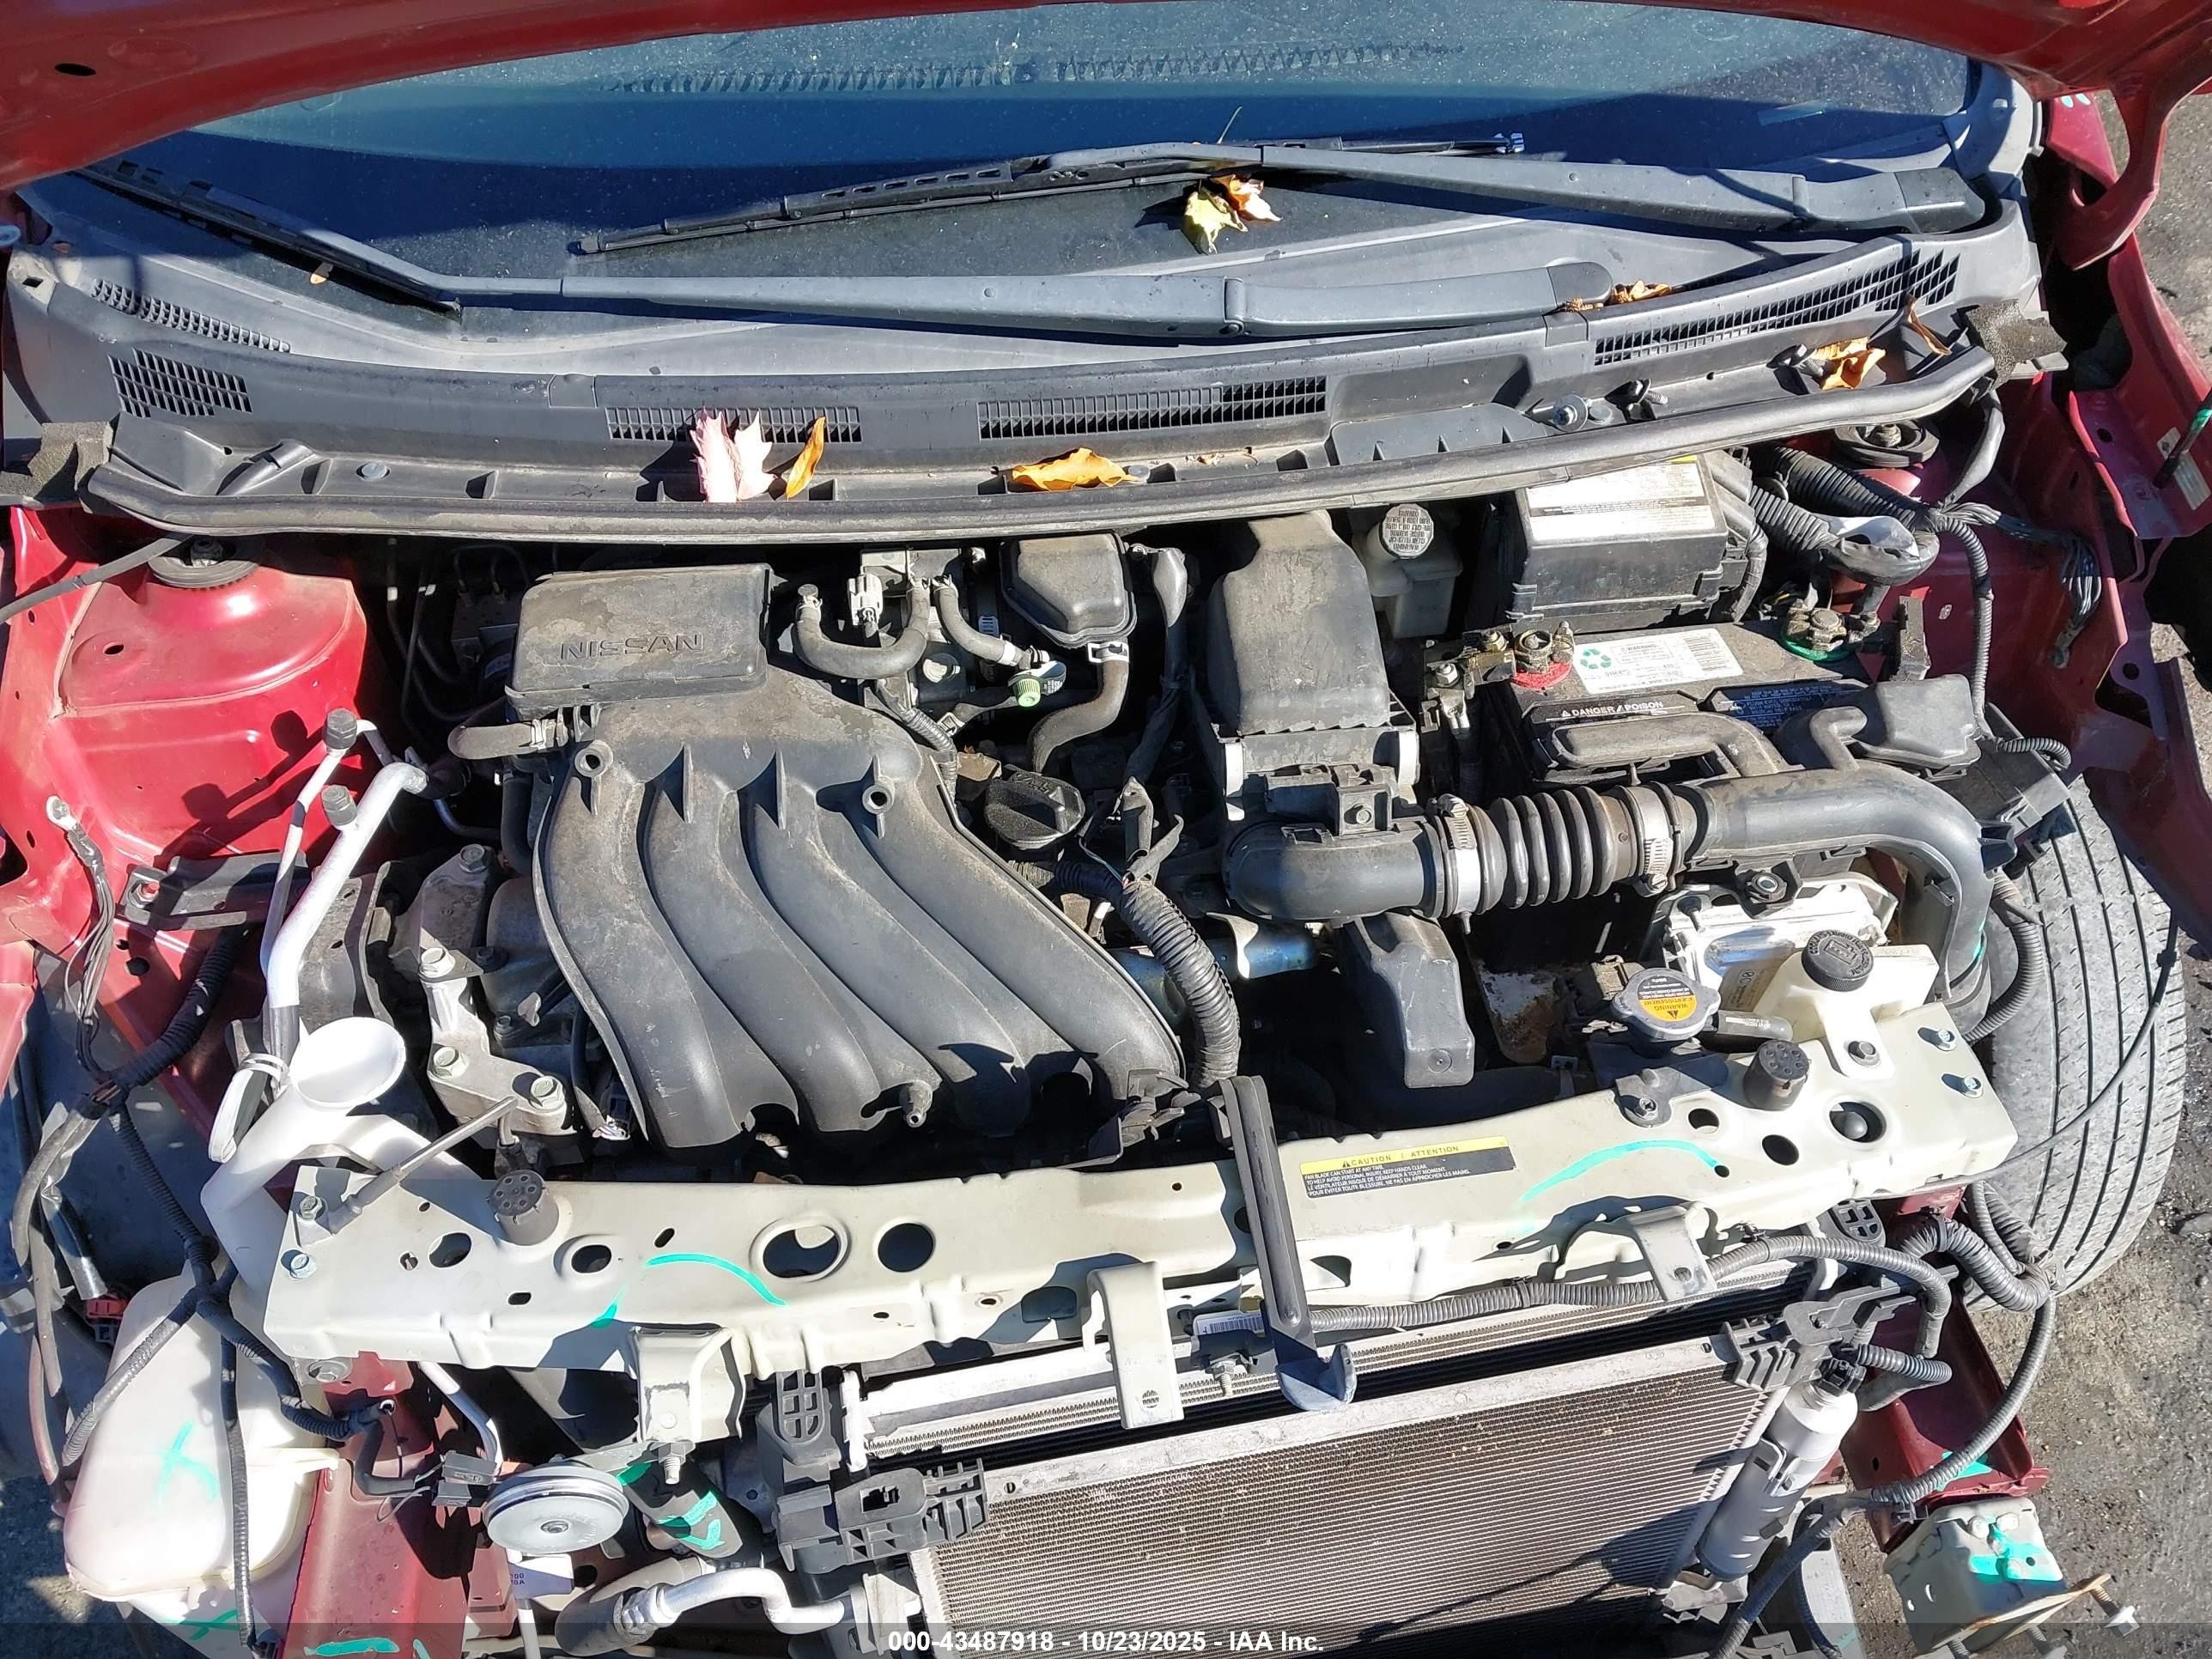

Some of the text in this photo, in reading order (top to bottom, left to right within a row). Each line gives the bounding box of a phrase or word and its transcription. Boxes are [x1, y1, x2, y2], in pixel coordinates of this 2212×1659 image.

[561, 632, 703, 660] NISSAN
[1654, 1003, 1688, 1012] WARNING
[1351, 1146, 1459, 1166] CAUTION ATTENTION
[1342, 1173, 1365, 1182] PERSONAL
[1412, 1173, 1443, 1182] APPROCHER
[1315, 1181, 1348, 1190] VENTILATEUR
